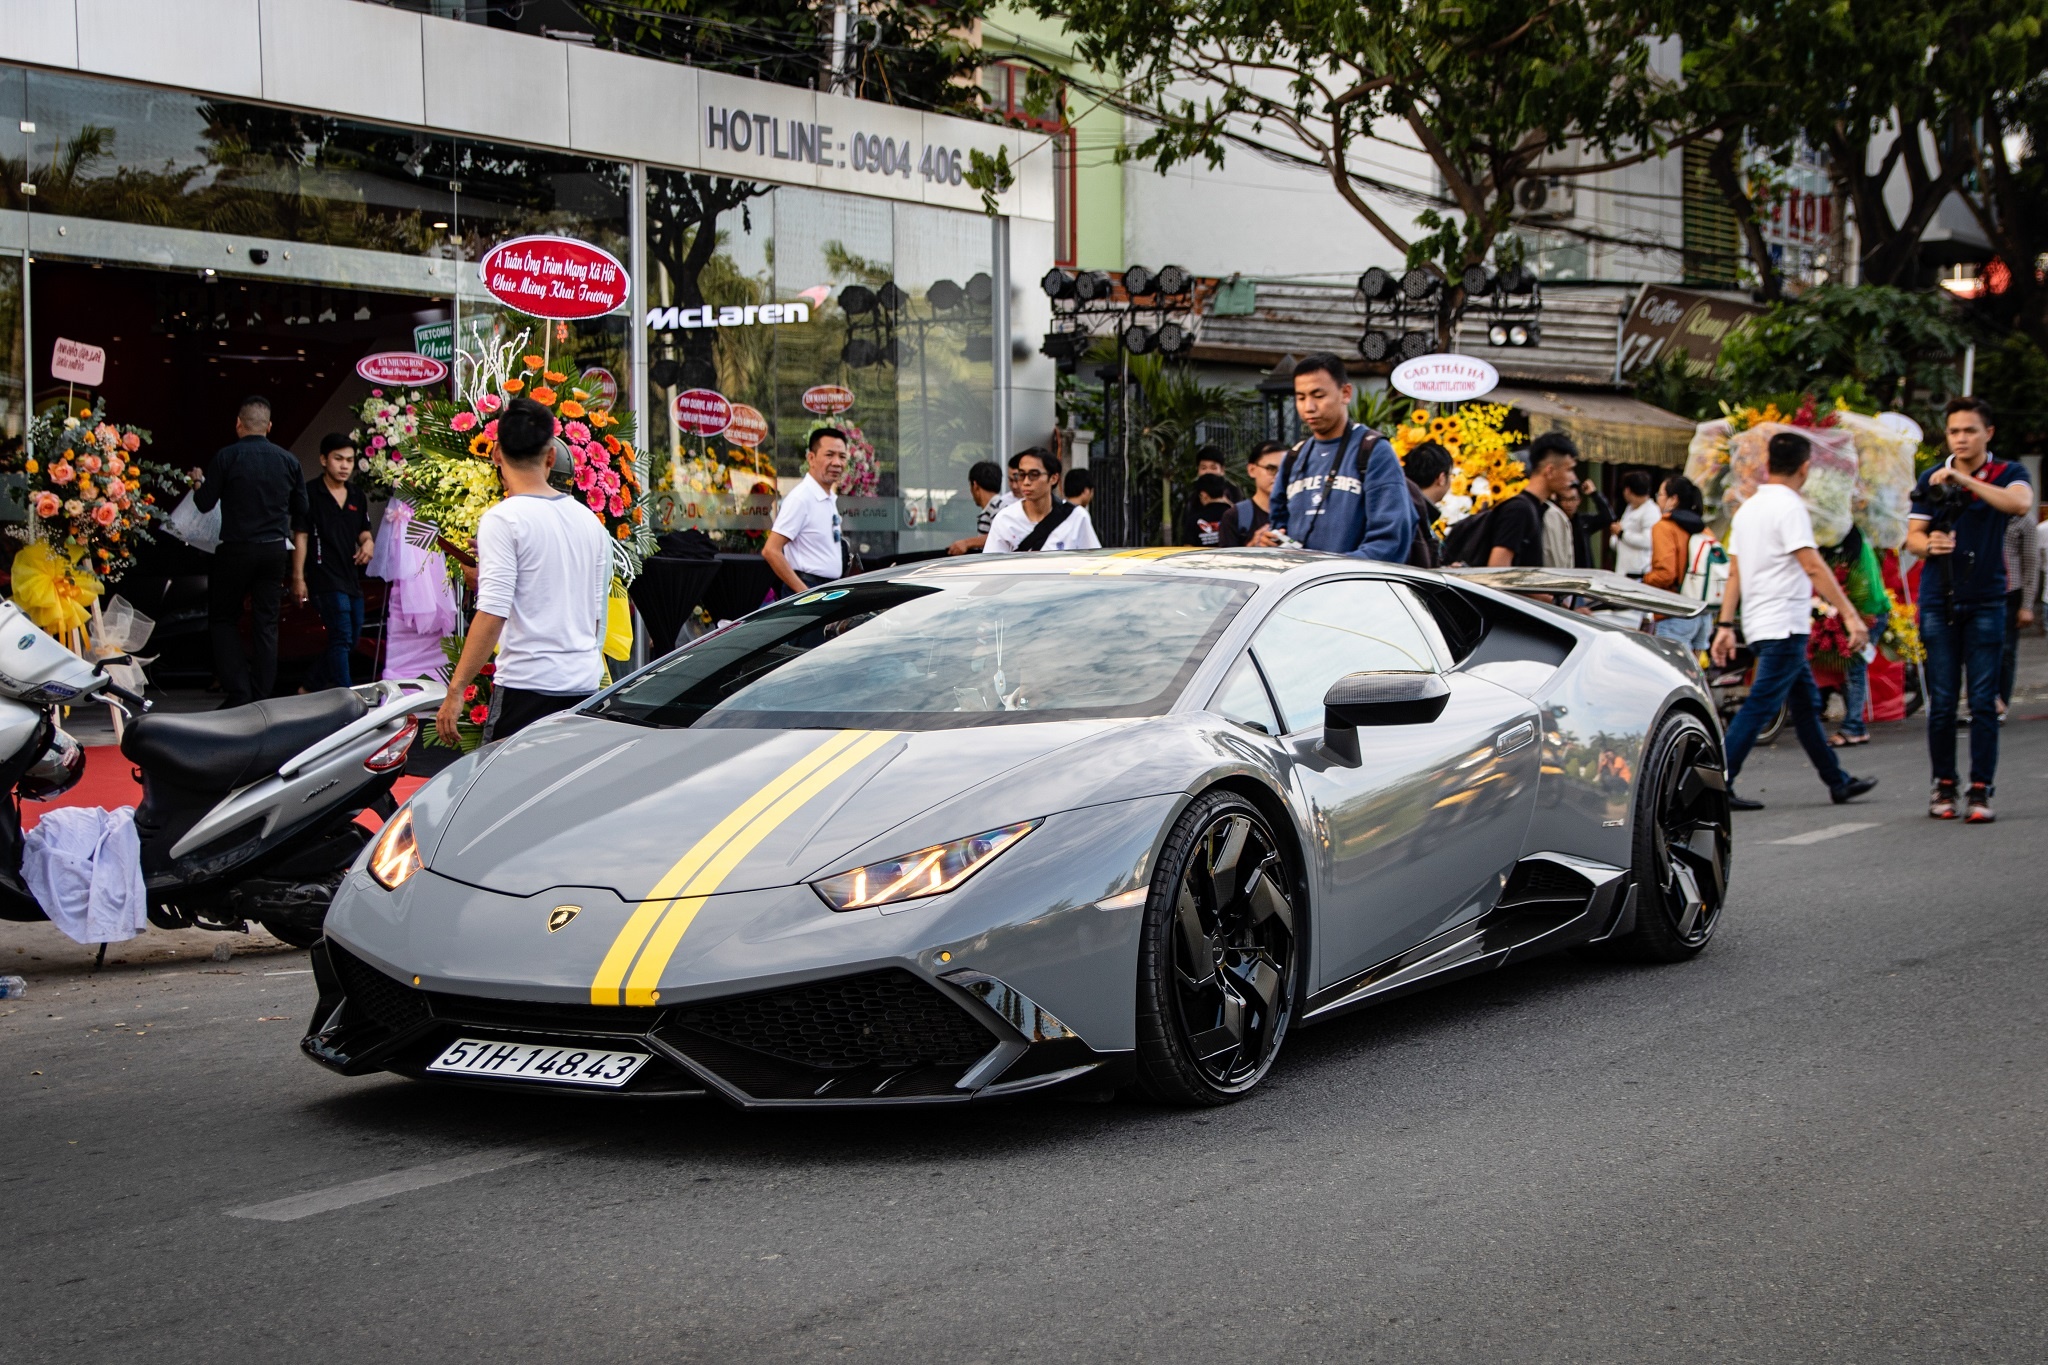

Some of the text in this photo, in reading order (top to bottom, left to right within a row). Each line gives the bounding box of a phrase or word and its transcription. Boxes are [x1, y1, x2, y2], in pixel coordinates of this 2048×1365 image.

[852, 130, 912, 179] 0904
[918, 144, 963, 187] 406
[494, 250, 503, 268] A
[523, 249, 541, 276] Ông
[542, 255, 563, 275] Trùm
[564, 258, 588, 283] Mạng
[588, 262, 602, 281] Xã
[601, 263, 617, 286] Hội
[492, 273, 614, 308] Chúc Mừng Khai Trương
[646, 303, 809, 330] McLaren
[1639, 295, 1684, 327] Coffee
[1403, 366, 1430, 380] CAO
[1413, 381, 1476, 392] CONGRATULATIONS
[442, 1041, 637, 1080] 51H-148.43
